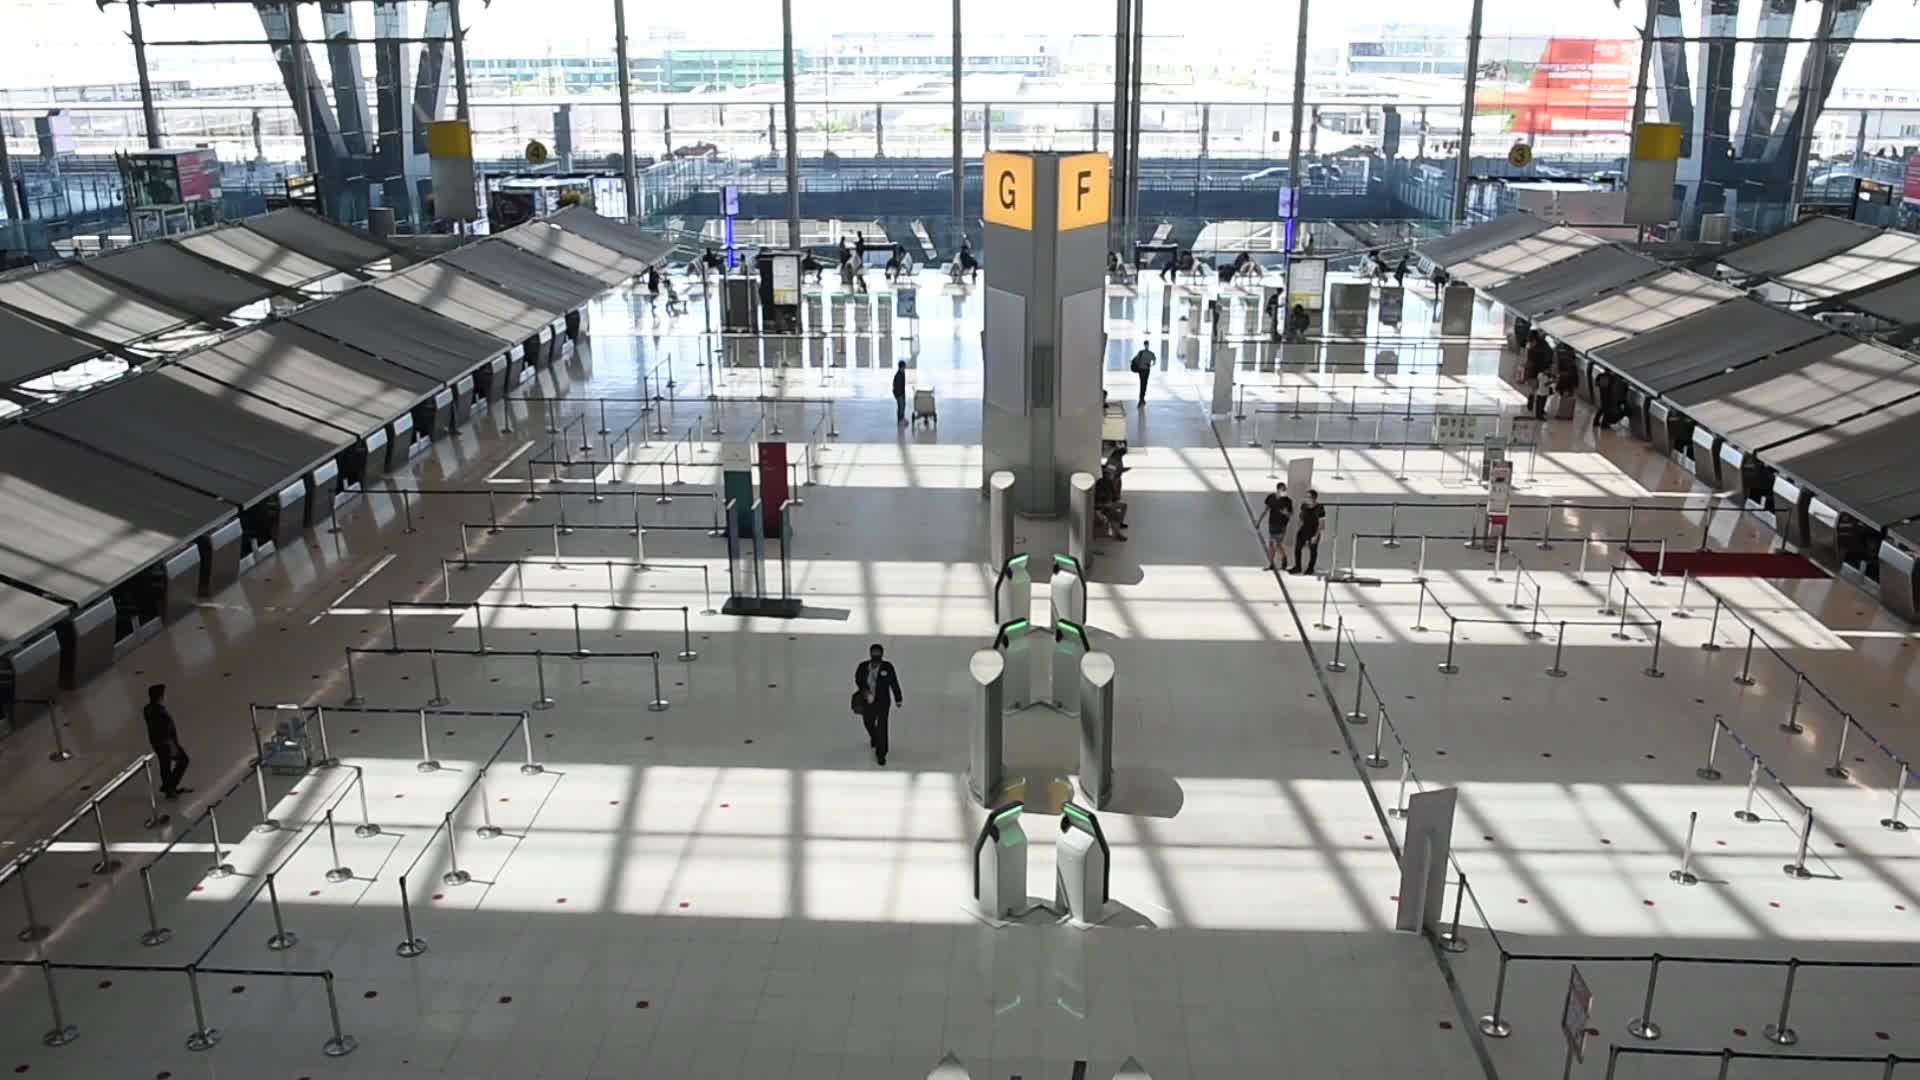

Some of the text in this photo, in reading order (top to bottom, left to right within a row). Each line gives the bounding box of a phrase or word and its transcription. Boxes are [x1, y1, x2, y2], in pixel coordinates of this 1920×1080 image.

[1514, 147, 1526, 163] 3
[999, 170, 1016, 210] G
[1077, 170, 1091, 212] F
